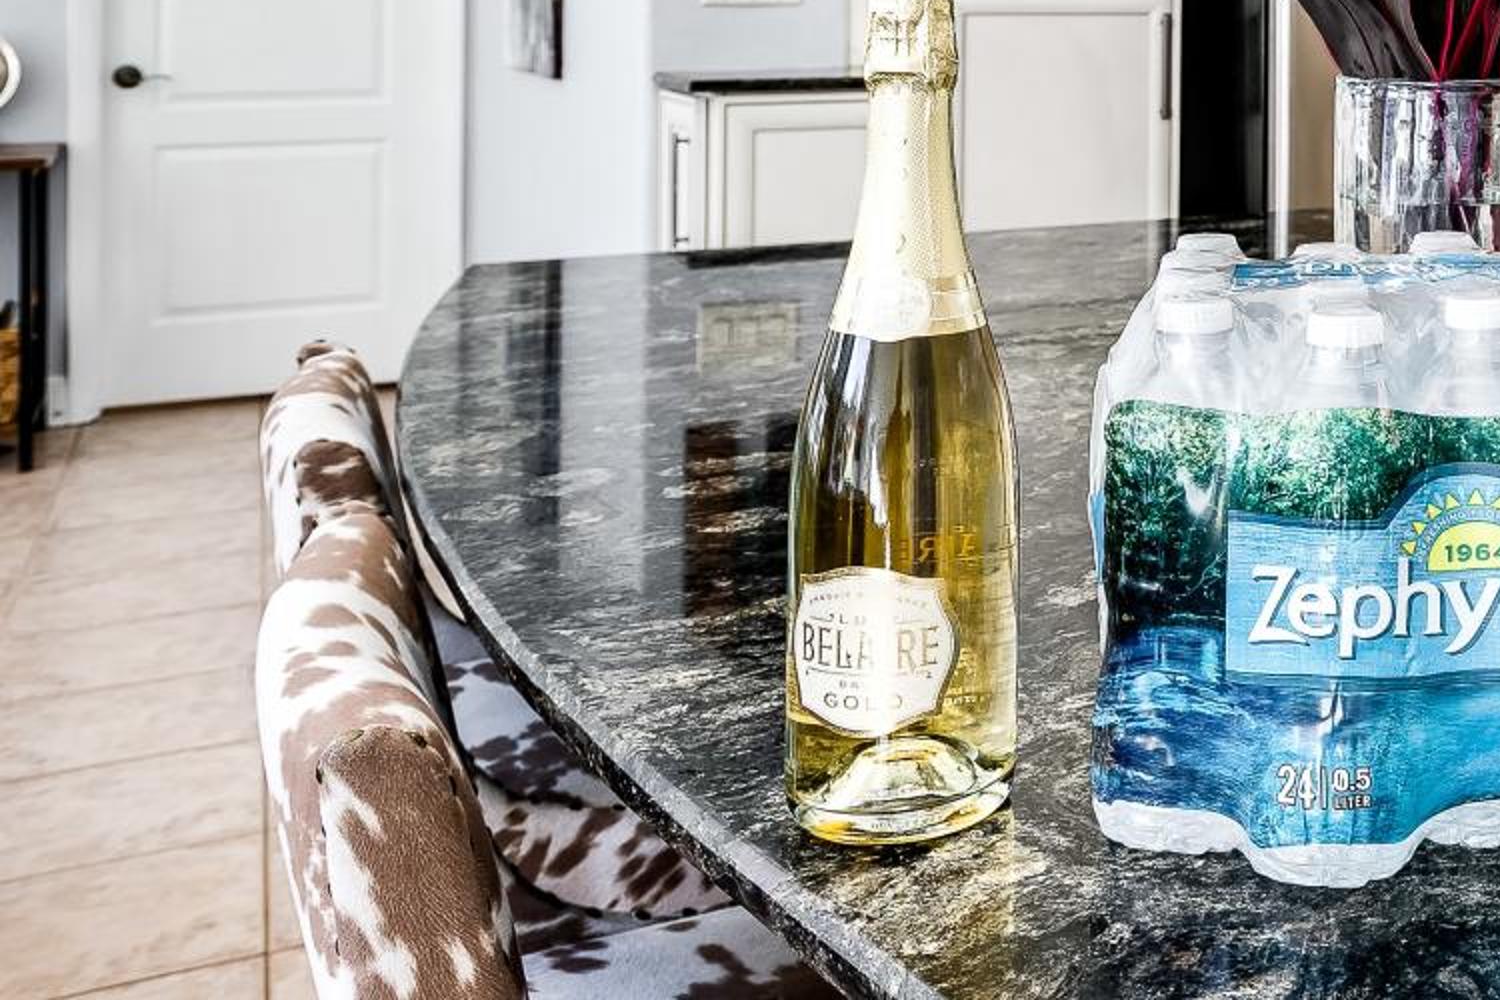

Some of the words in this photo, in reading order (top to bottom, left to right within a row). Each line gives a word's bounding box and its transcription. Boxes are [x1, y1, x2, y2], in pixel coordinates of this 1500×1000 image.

[802, 620, 940, 675] BELARE
[1277, 763, 1316, 810] 24
[1333, 768, 1371, 792] 0.5
[1334, 795, 1371, 810] LITER
